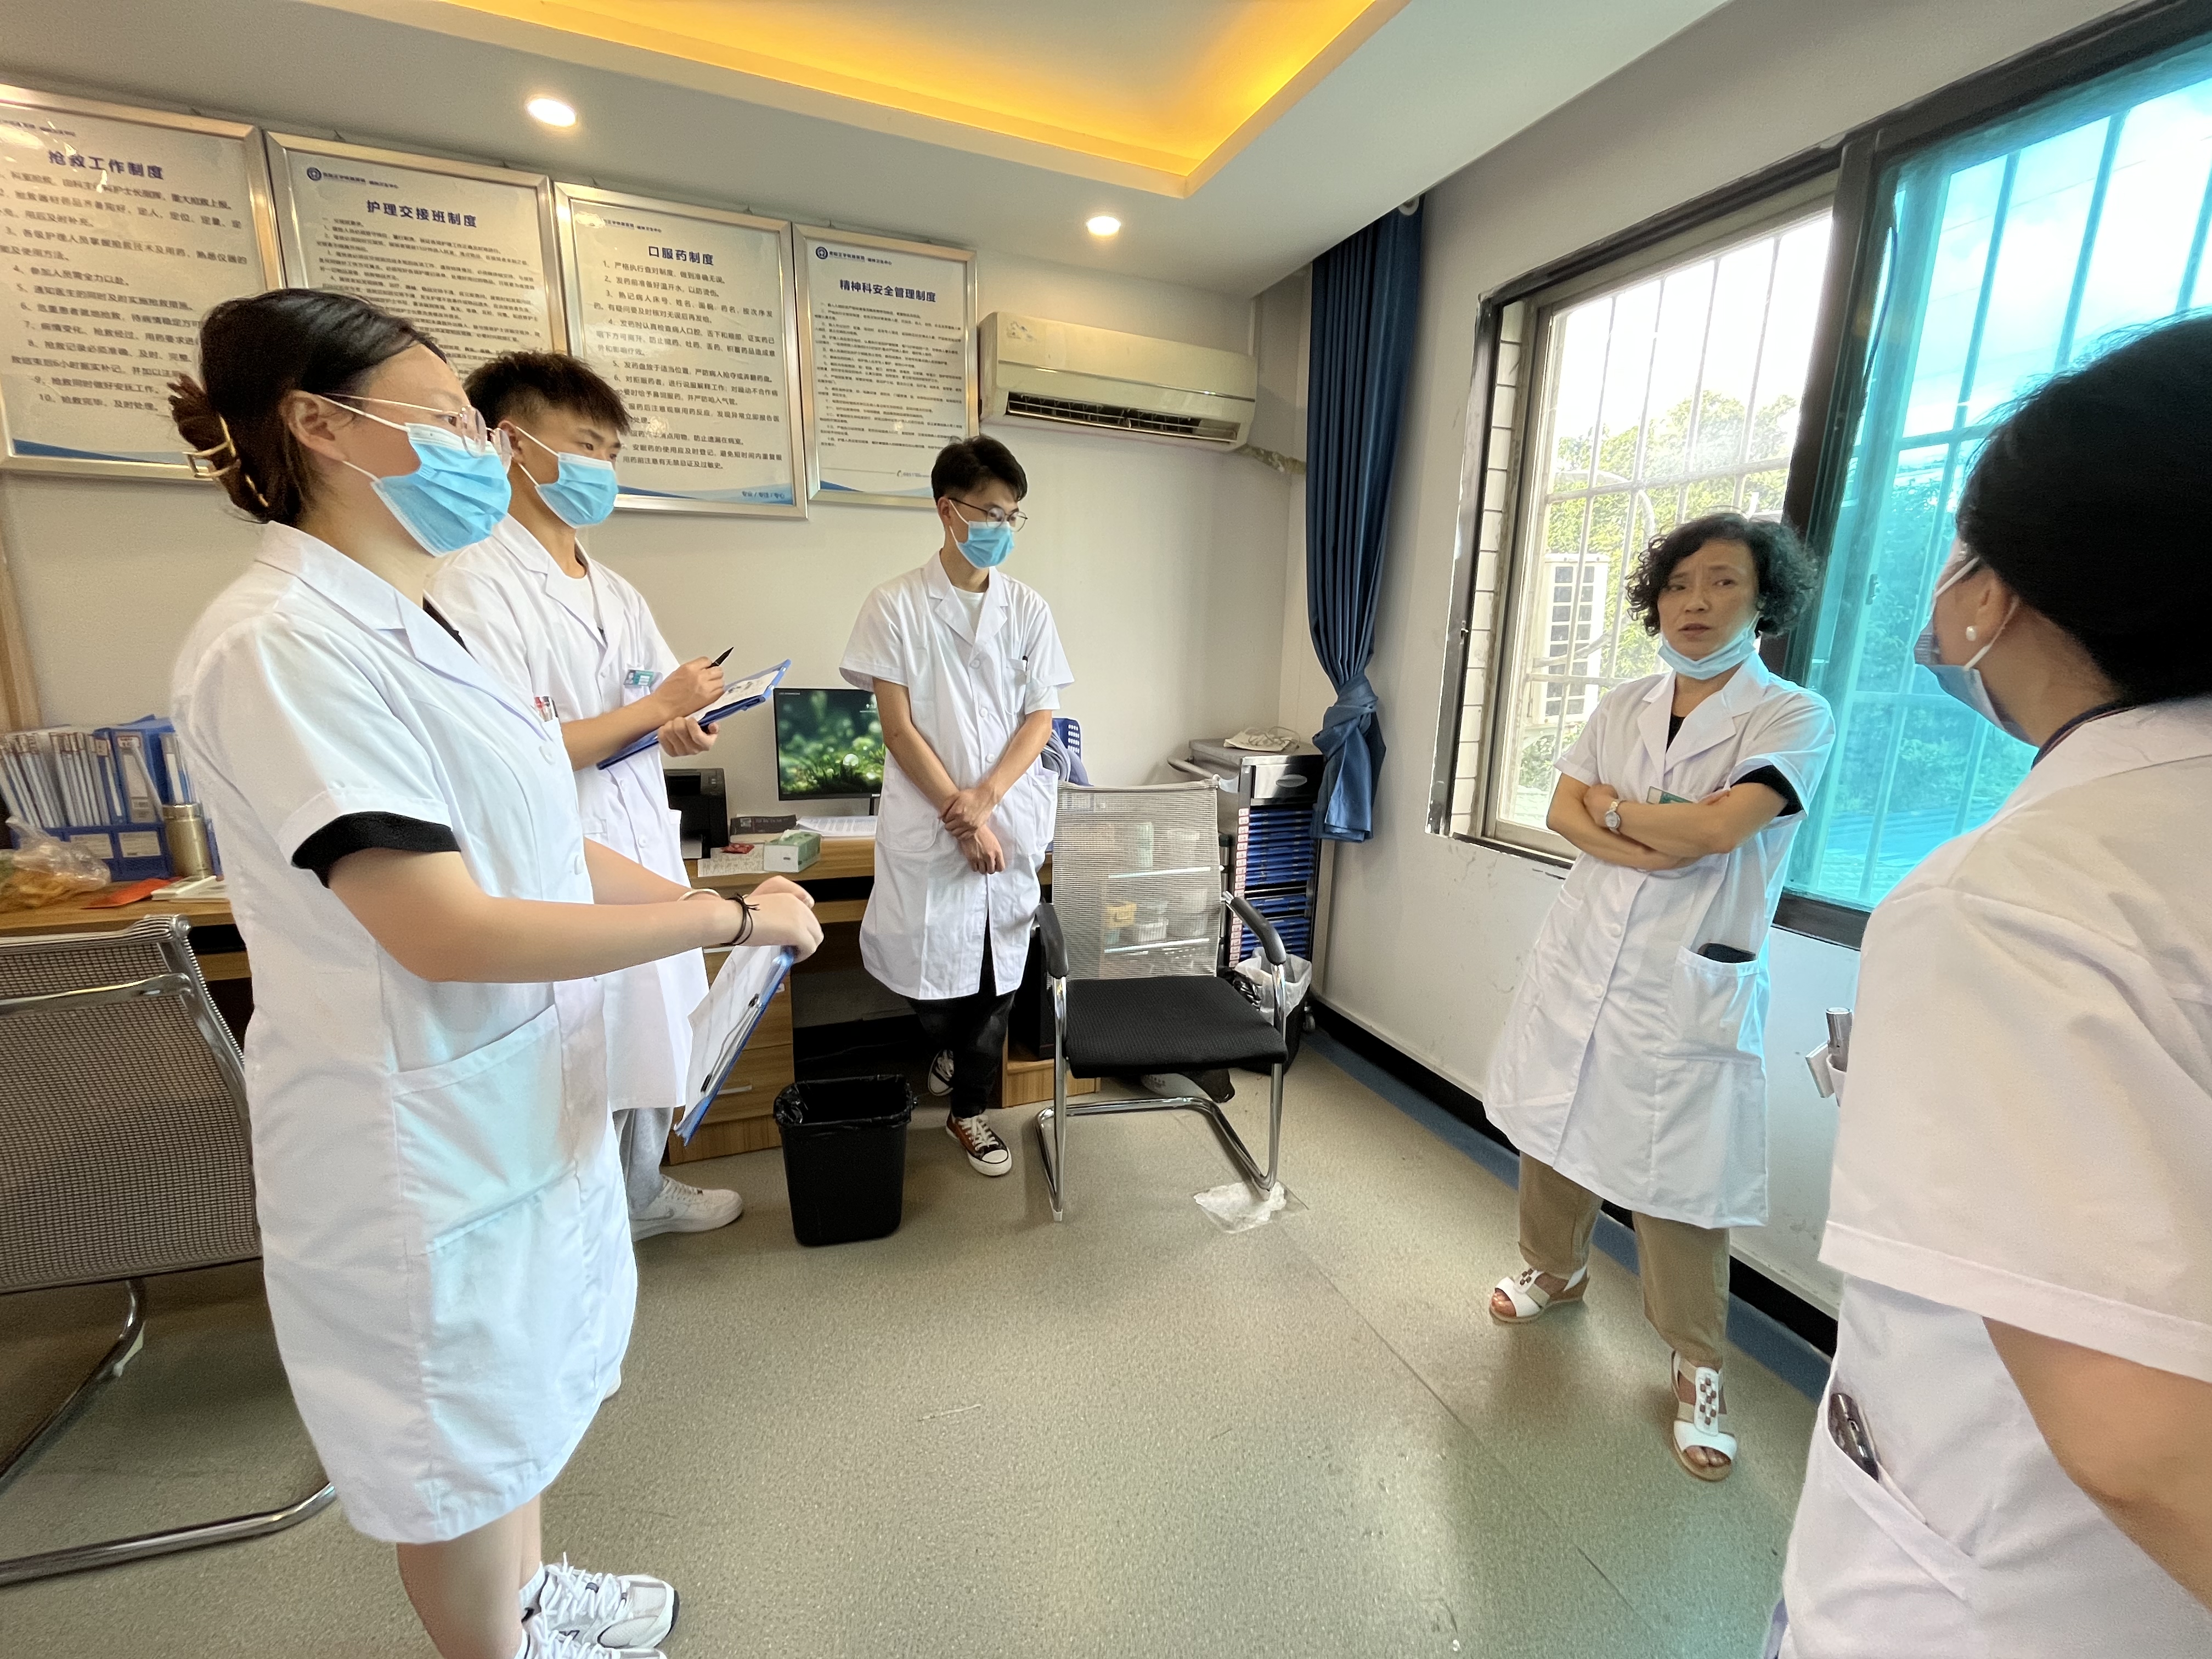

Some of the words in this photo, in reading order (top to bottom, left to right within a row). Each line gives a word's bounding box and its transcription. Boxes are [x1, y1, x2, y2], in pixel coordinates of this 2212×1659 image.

[48, 150, 165, 180] 抢救工作制度
[366, 199, 477, 228] 护理交接班制度
[648, 245, 714, 266] 口服药制度
[839, 279, 936, 302] 精神科安全管理制度
